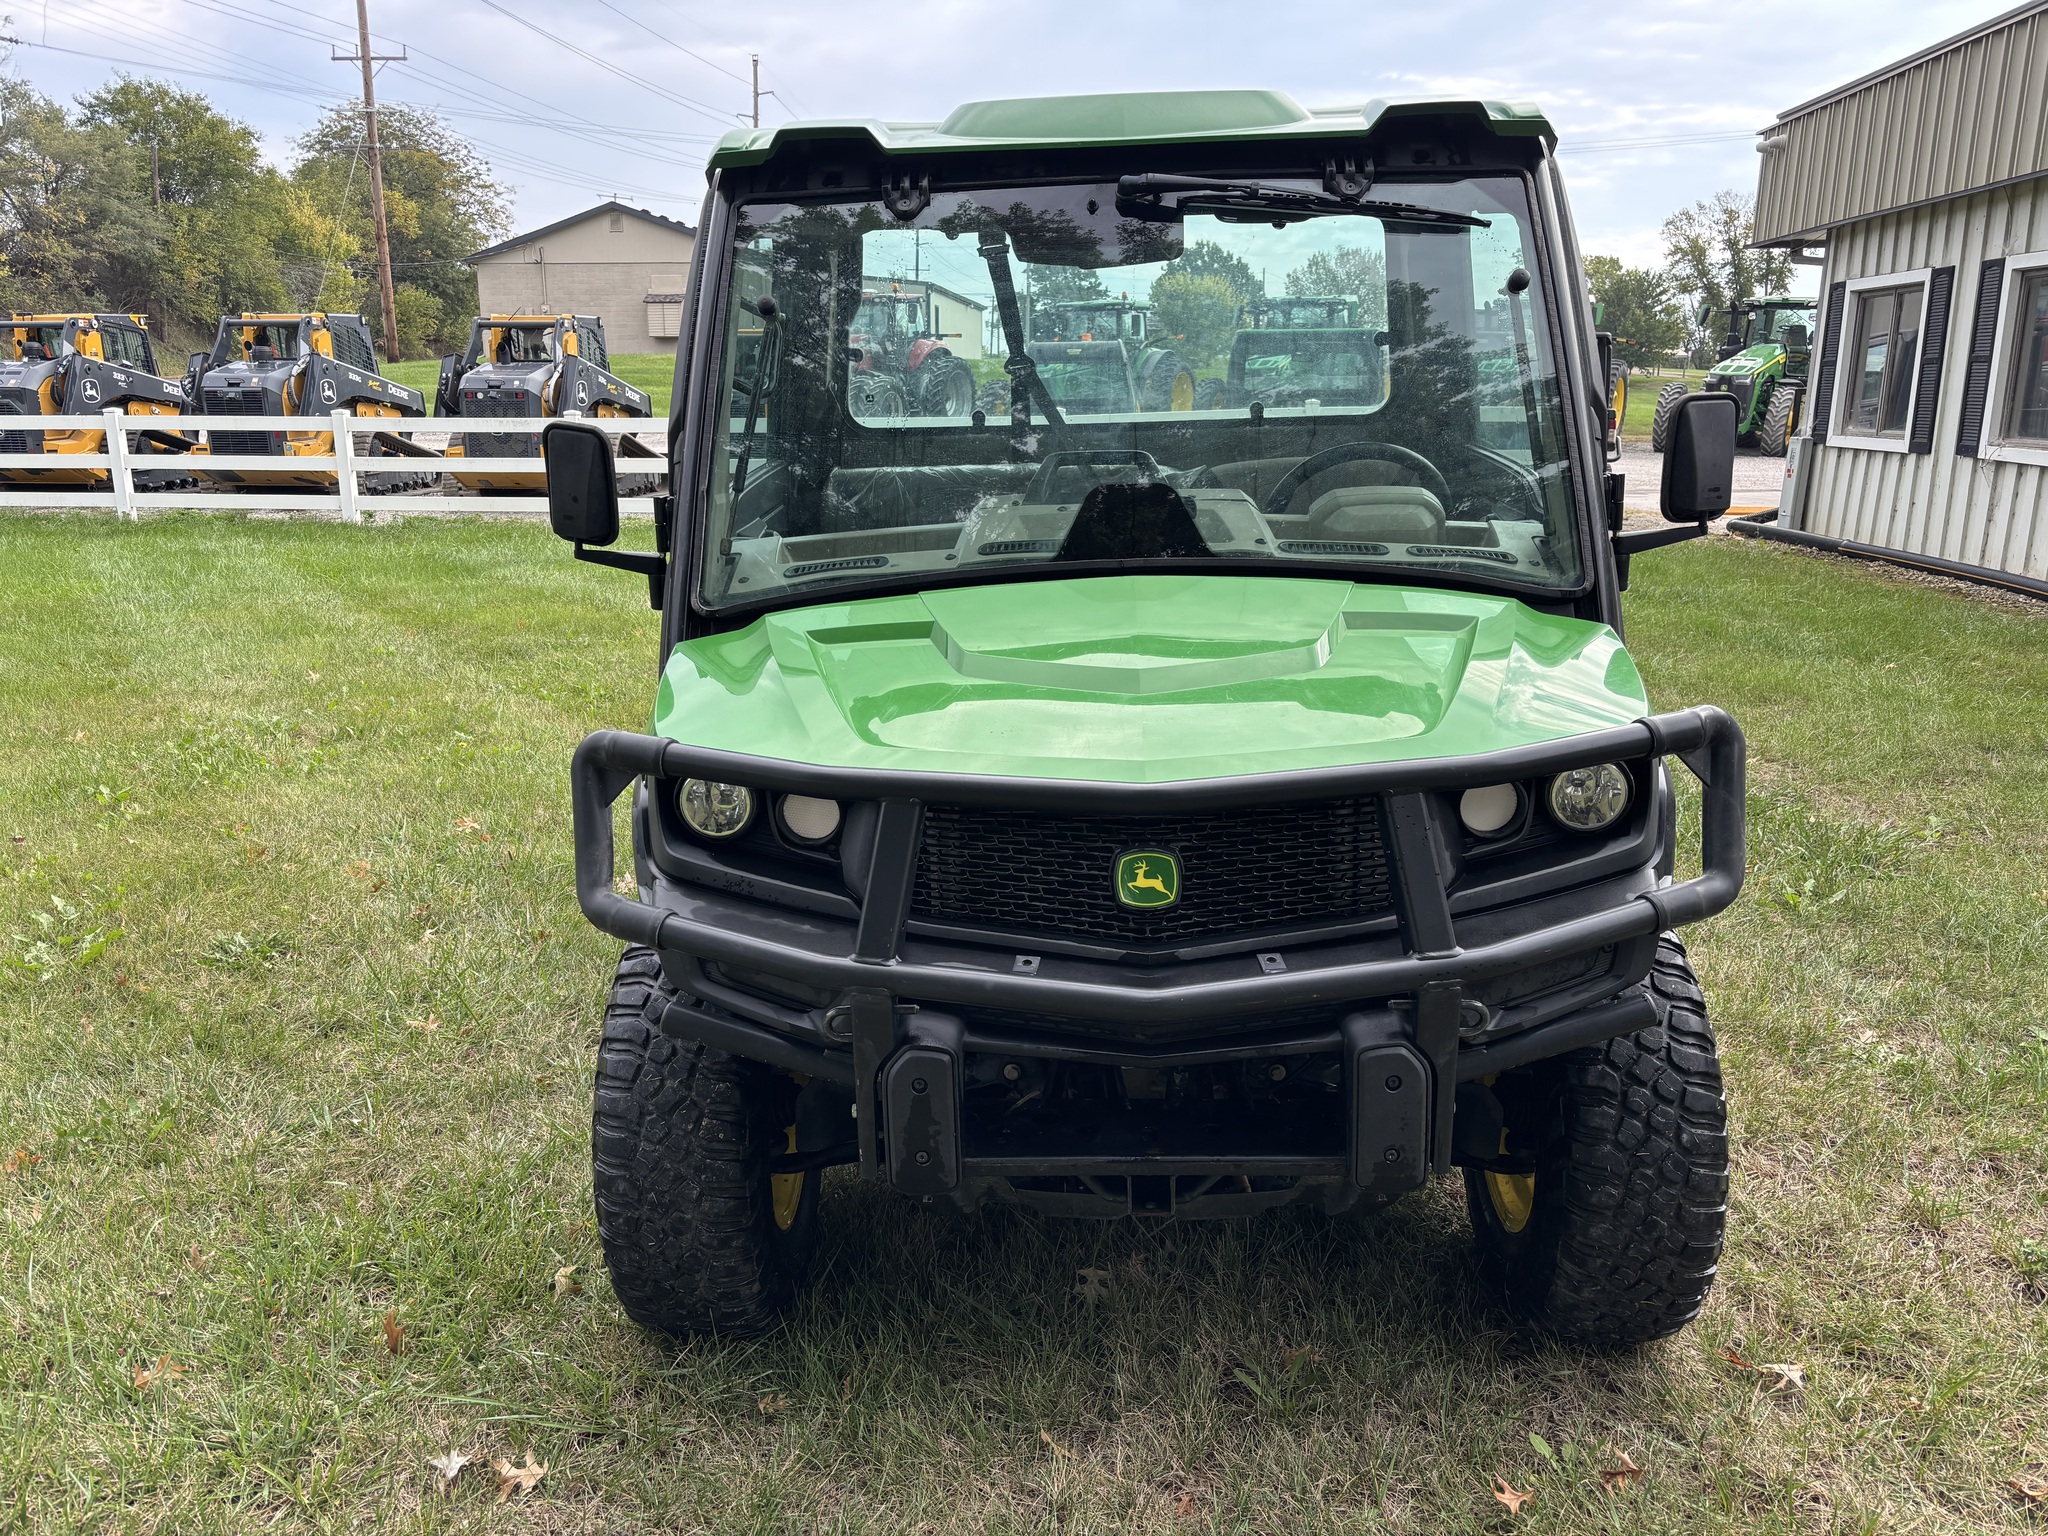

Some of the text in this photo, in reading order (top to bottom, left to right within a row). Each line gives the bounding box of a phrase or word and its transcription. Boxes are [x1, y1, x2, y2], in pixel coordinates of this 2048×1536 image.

[162, 382, 181, 396] DEE
[388, 383, 409, 400] DEERE
[625, 386, 641, 403] DEERE
